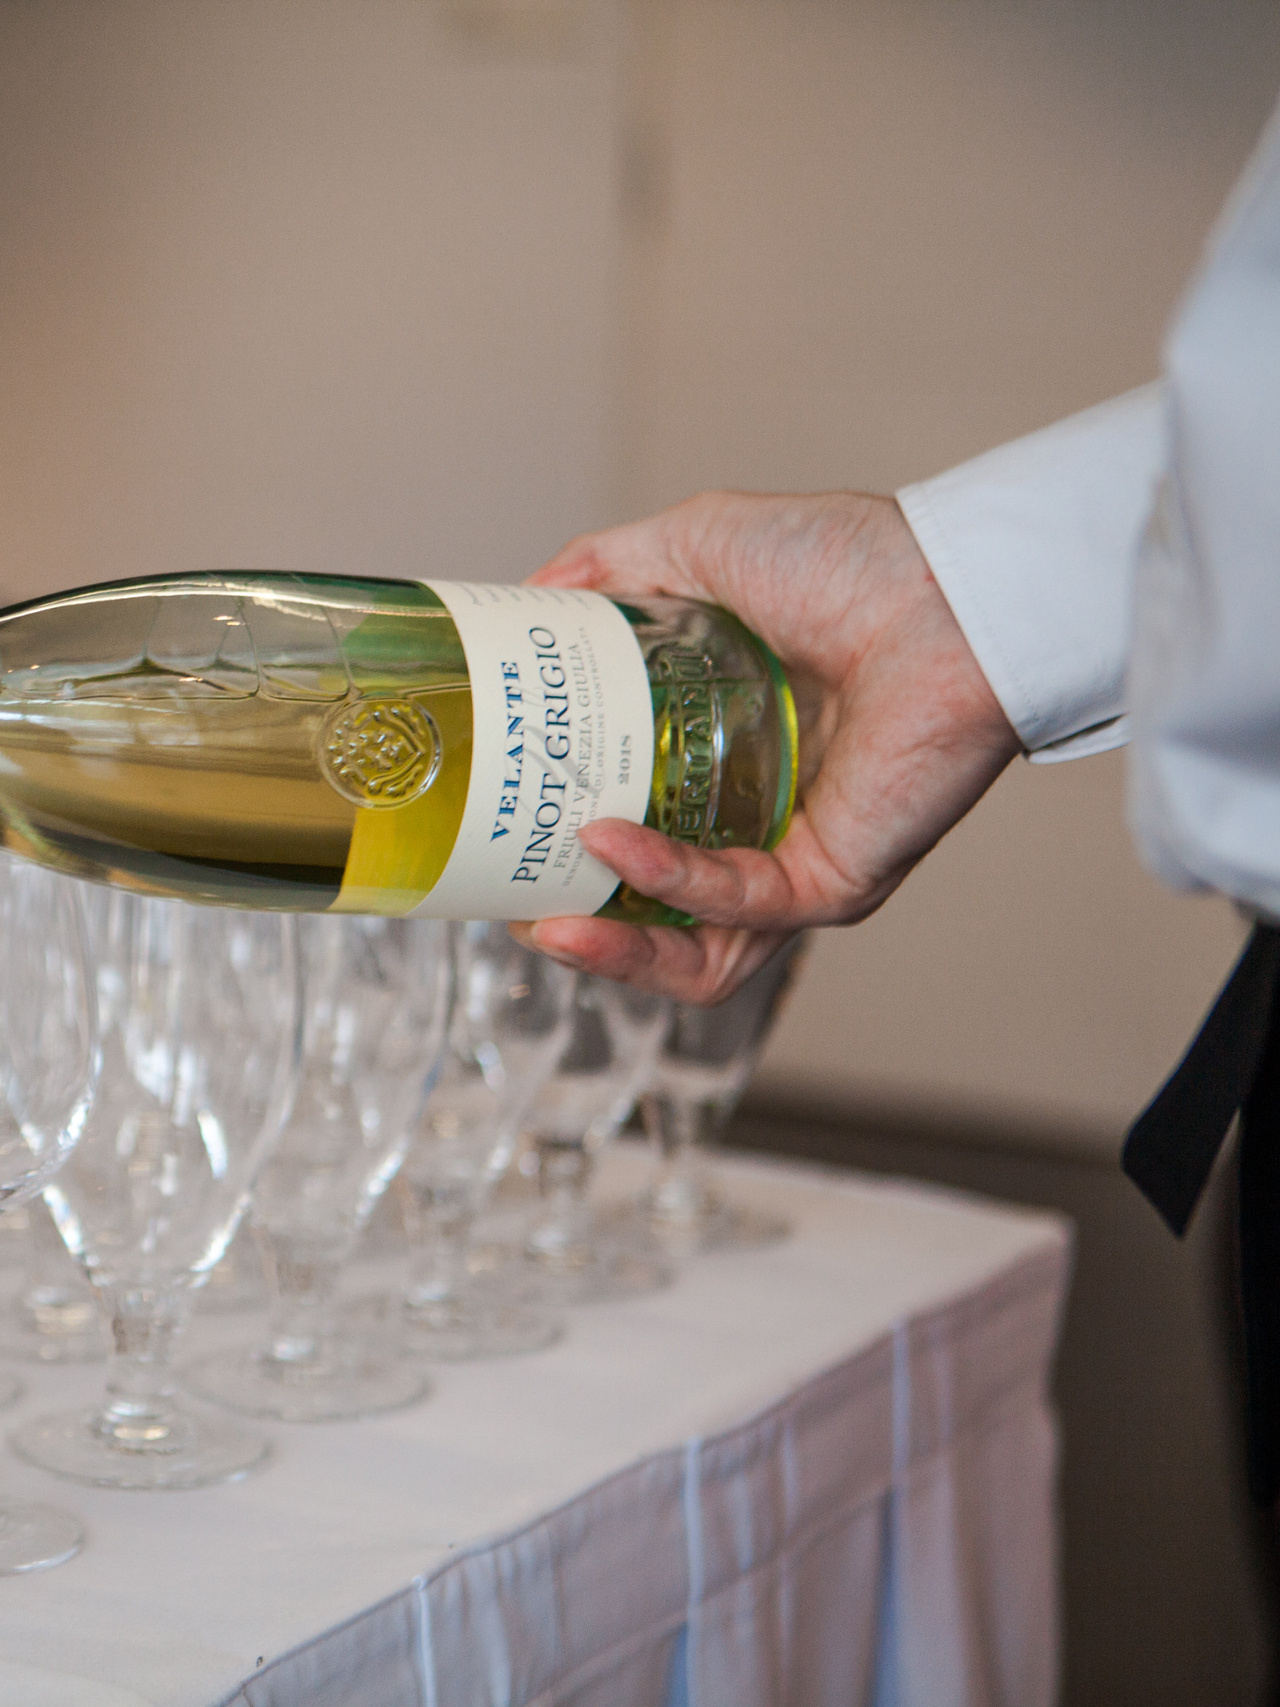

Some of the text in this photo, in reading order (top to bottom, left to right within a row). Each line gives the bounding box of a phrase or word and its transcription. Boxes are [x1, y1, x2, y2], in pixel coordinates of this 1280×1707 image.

[489, 661, 524, 843] VELANTE
[511, 627, 571, 884] PINOT GRIGIO
[553, 643, 593, 868] FRIULI VENEZIA GIULIA
[595, 712, 606, 768] ORIGINE
[618, 734, 631, 786] 2018
[671, 653, 712, 842] ERTANI
